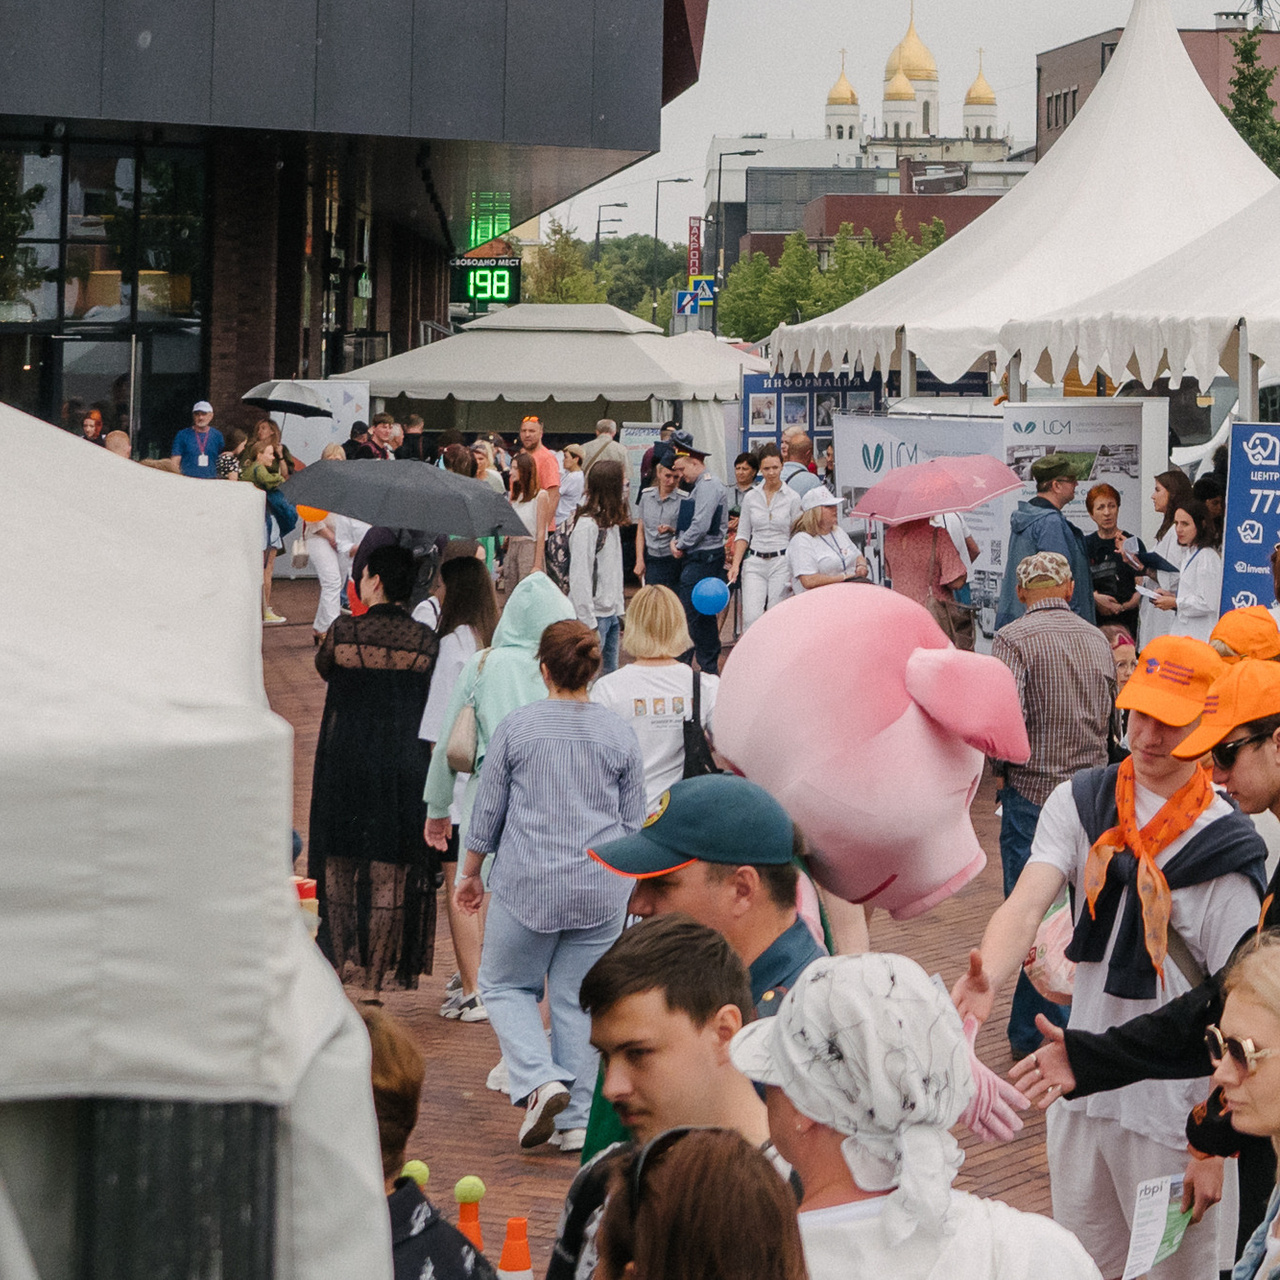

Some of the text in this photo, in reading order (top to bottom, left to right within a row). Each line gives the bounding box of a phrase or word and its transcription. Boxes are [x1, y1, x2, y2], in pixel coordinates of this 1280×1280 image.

[690, 226, 699, 275] АКРОПО
[450, 258, 519, 267] СВОБОДНО МЕСТ
[469, 270, 509, 298] 198
[763, 378, 861, 388] ИНФОРМАЦИЯ
[1250, 471, 1280, 481] ЦЕНТР
[1247, 563, 1271, 574] invent
